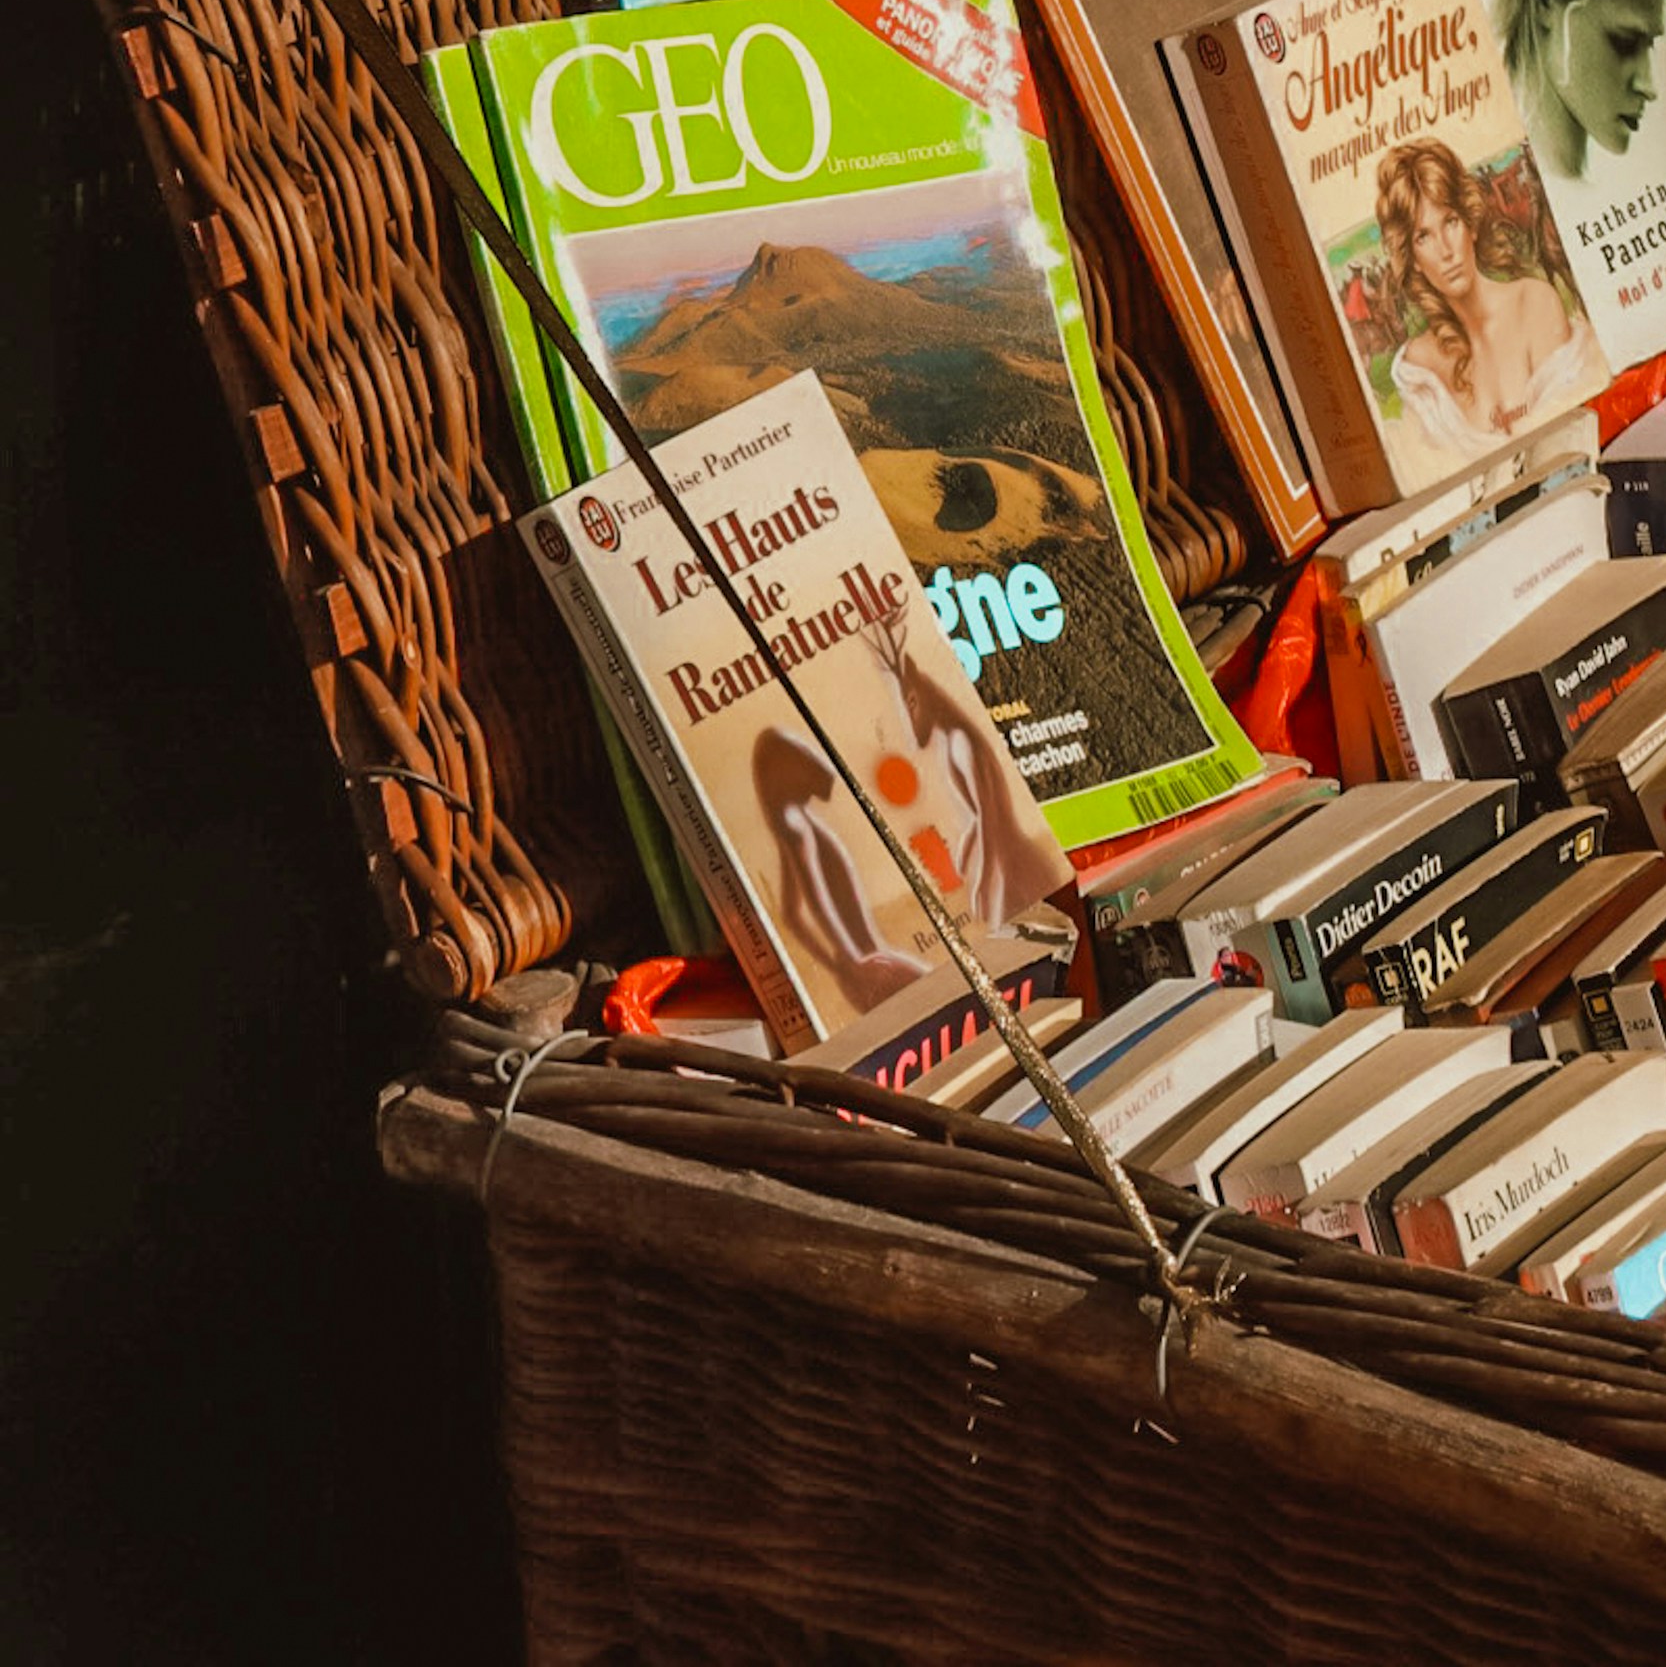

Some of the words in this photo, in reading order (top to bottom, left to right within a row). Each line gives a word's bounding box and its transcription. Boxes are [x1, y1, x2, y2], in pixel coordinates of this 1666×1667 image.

[875, 17, 893, 35] et
[1286, 1, 1329, 44] Anne
[1284, 5, 1479, 133] Angélique,
[530, 21, 833, 208] GEO
[1309, 119, 1391, 184] marquise
[1392, 96, 1423, 142] des
[1422, 69, 1492, 126] Anges
[826, 155, 846, 175] Un
[849, 150, 906, 172] nouveau
[1617, 276, 1649, 310] Moi
[701, 420, 794, 479] Parturier
[702, 484, 841, 578] Hauts
[744, 572, 791, 625] de
[663, 561, 909, 728] Ramatuelle
[1554, 670, 1581, 700] Ryan
[1576, 645, 1606, 682] David
[1009, 709, 1089, 749] charmes
[1315, 898, 1377, 960] Didier
[1373, 852, 1444, 917] Decoin
[1623, 1018, 1656, 1034] 2424
[1464, 1208, 1498, 1244] Iris
[1494, 1145, 1571, 1216] Murdoch
